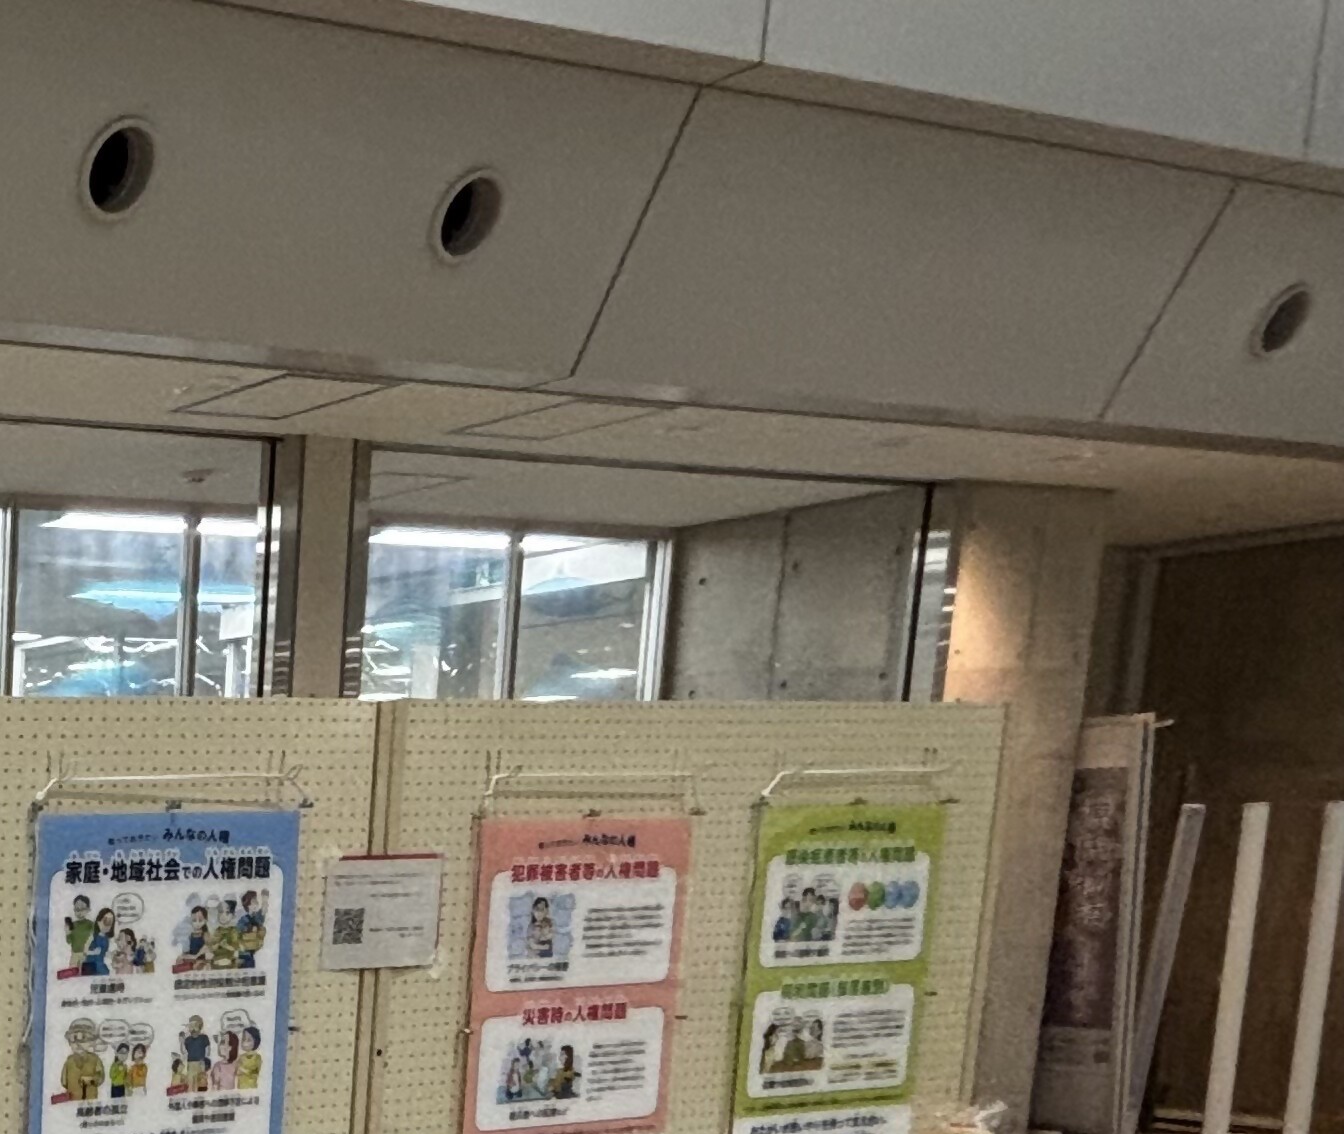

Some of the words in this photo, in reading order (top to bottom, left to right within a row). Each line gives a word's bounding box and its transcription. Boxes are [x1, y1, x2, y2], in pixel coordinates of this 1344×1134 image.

[65, 855, 271, 885] 家庭・地域社会での人権問題
